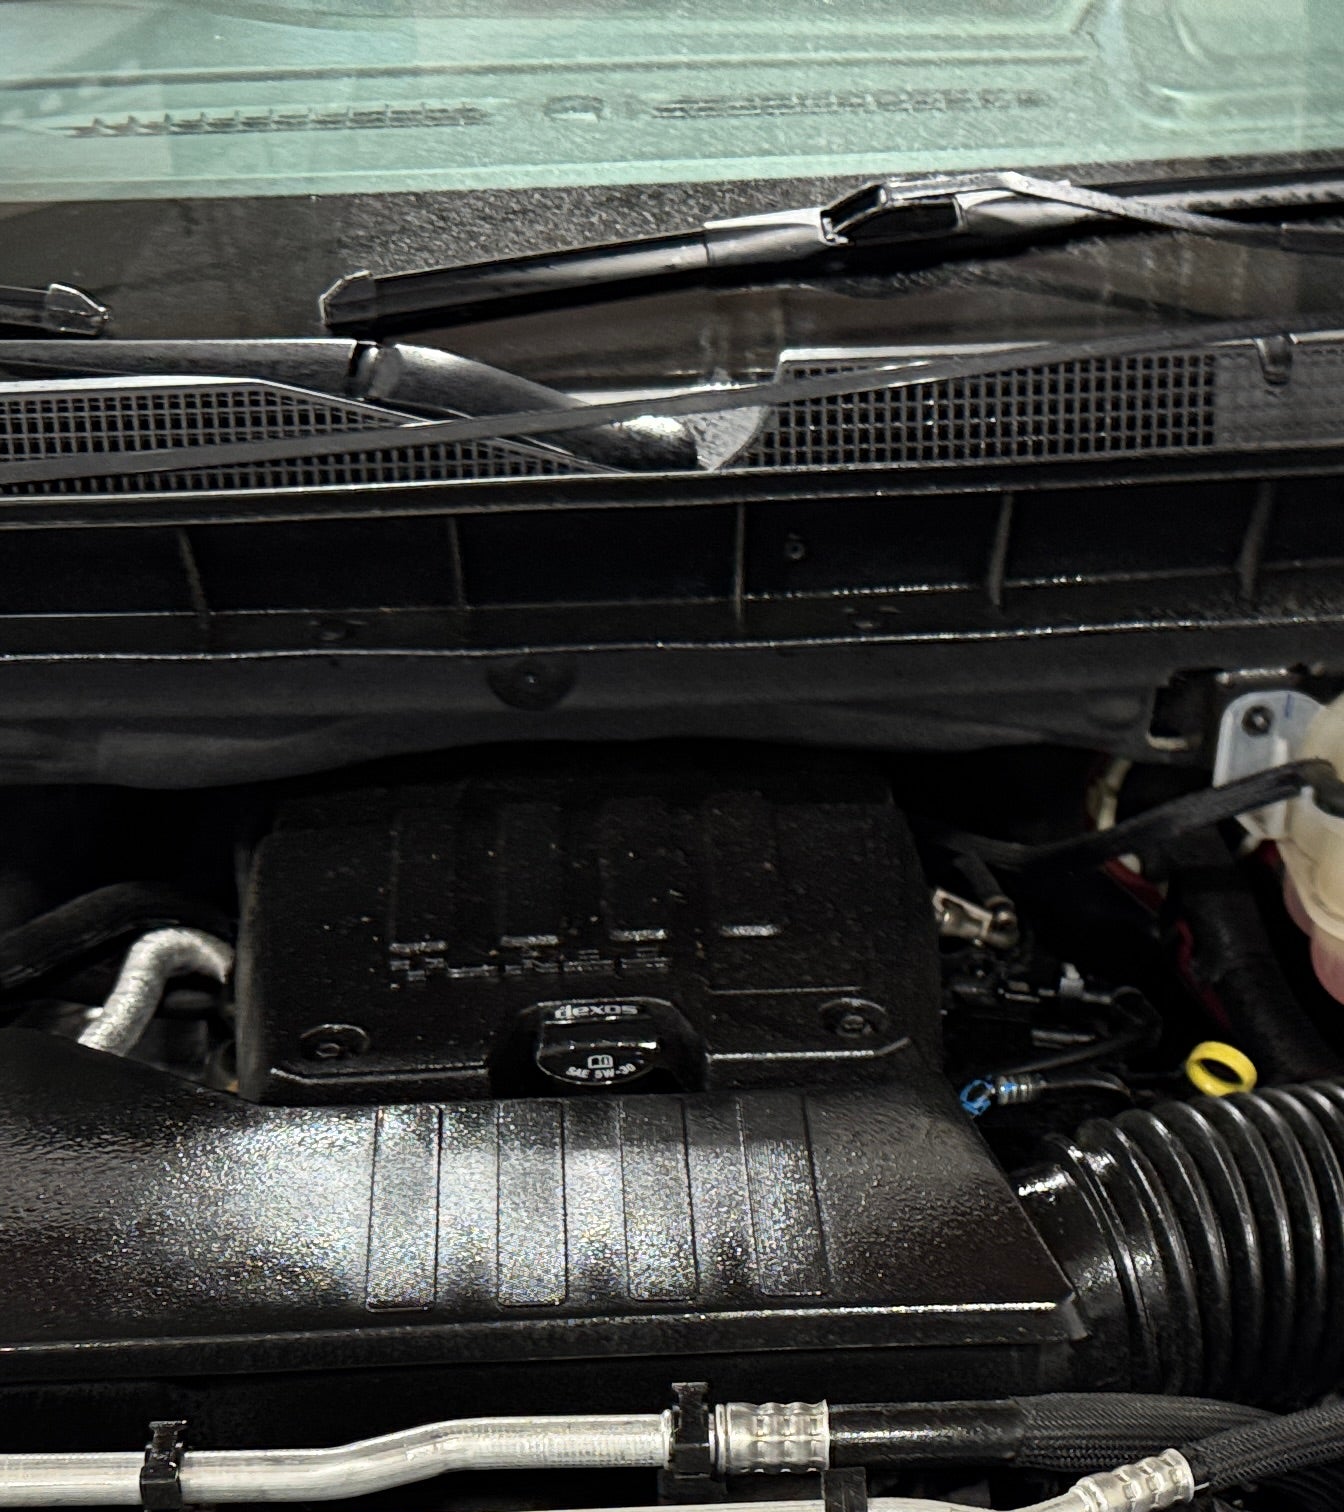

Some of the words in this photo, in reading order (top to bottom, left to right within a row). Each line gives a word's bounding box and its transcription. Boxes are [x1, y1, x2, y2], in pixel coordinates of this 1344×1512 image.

[555, 1004, 638, 1019] dexos
[566, 1066, 591, 1079] SAE
[594, 1063, 637, 1079] 5W-30
